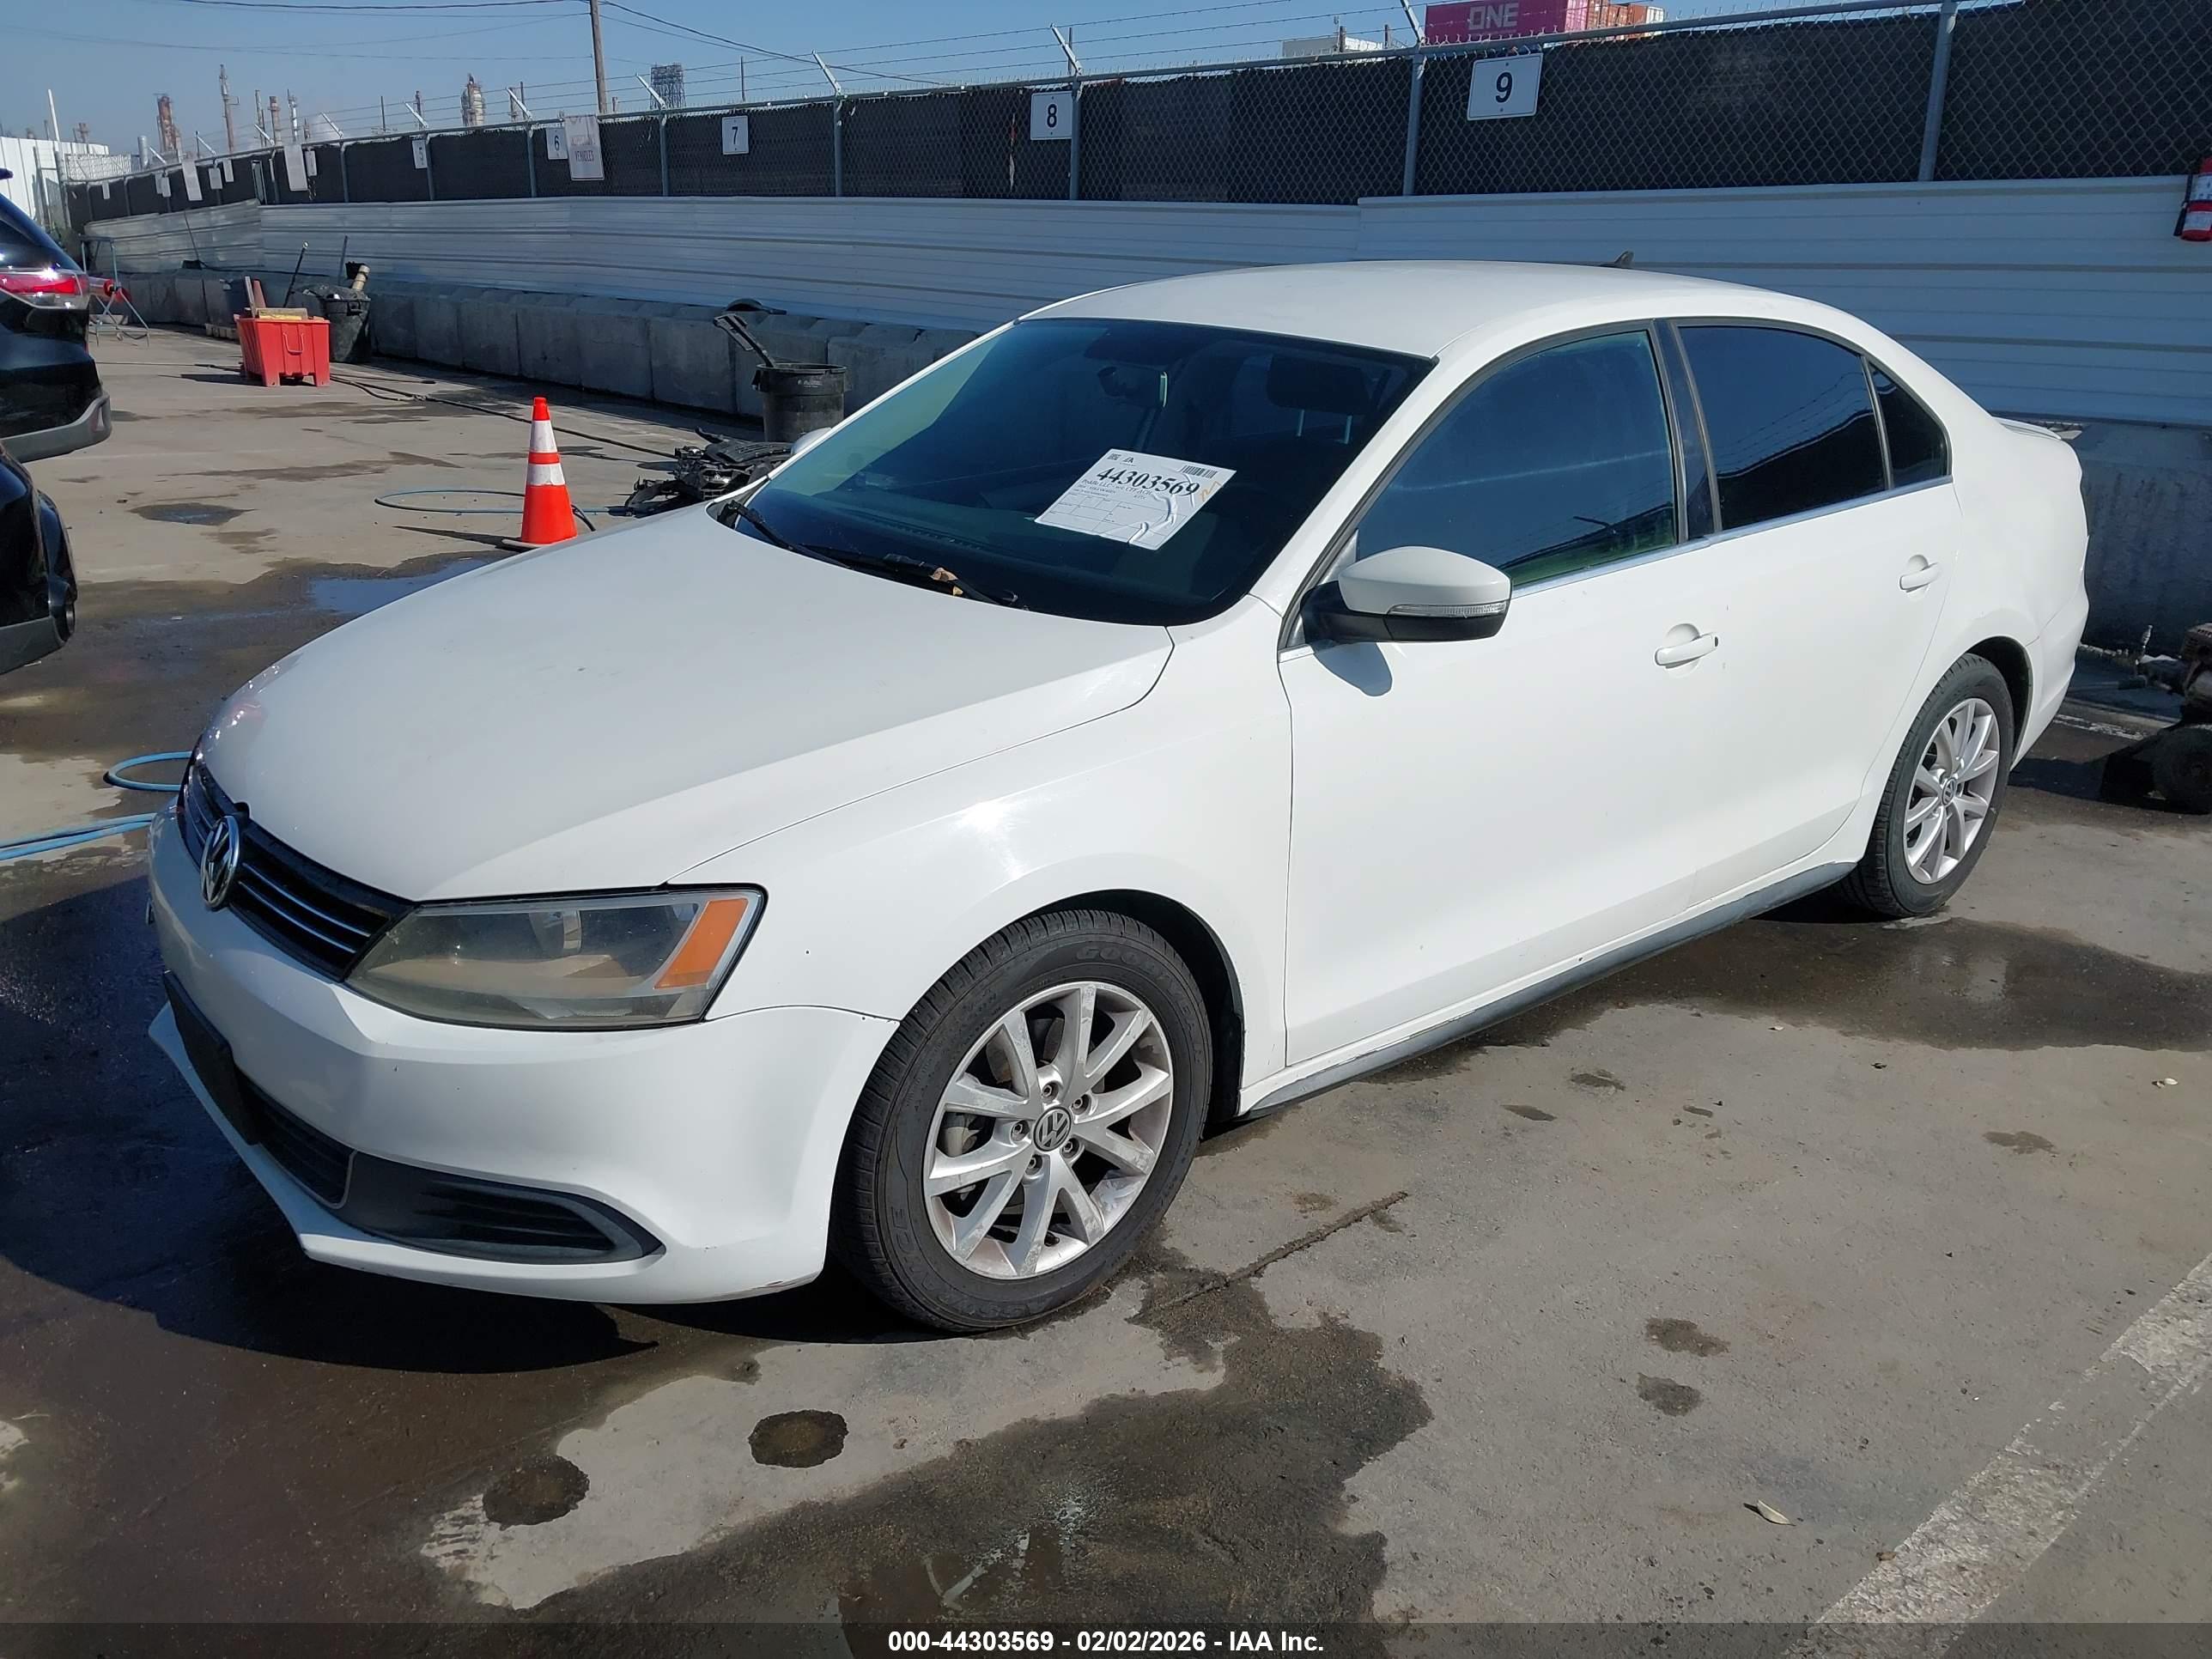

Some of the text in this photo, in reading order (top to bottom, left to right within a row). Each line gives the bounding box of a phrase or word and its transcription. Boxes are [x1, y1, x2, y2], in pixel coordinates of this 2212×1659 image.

[1468, 3, 1519, 30] ONE
[1495, 72, 1513, 103] 9
[1047, 103, 1057, 128] 8
[554, 135, 561, 151] 6
[732, 126, 738, 145] 7
[1097, 467, 1200, 496] 44303569
